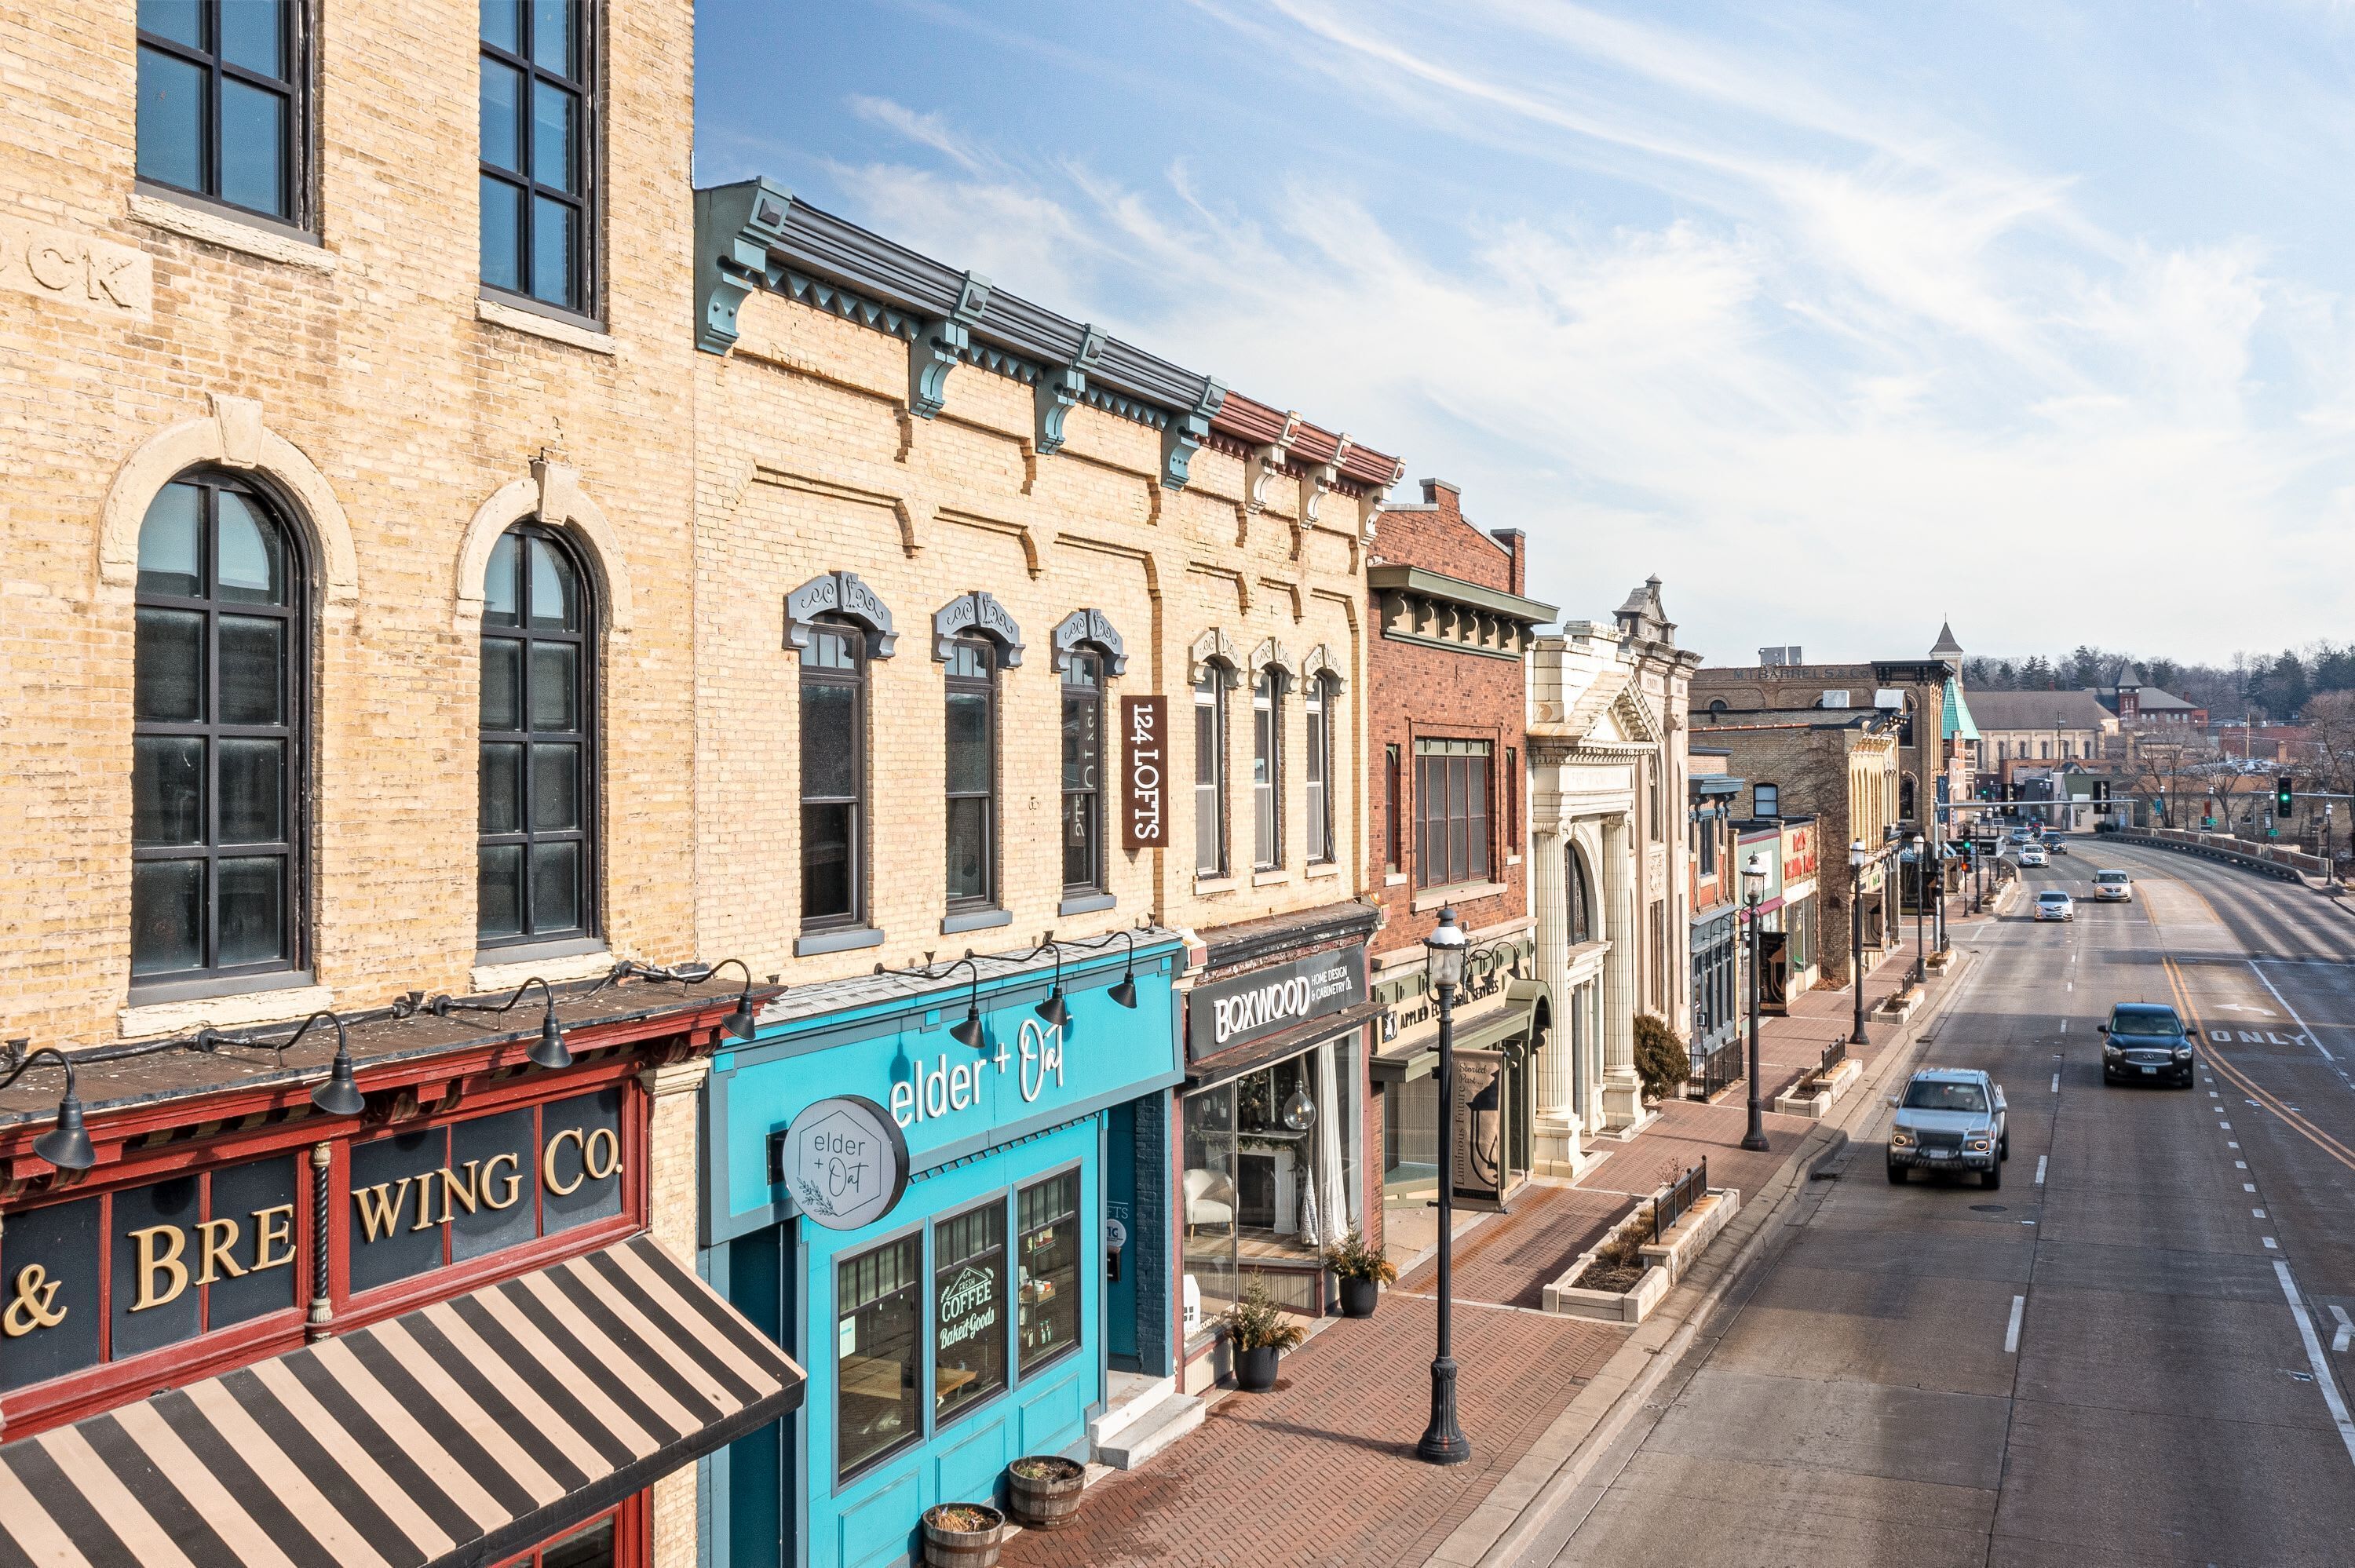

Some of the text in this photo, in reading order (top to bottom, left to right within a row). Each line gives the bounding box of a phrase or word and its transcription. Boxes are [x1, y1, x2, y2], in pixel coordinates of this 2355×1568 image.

[0, 240, 133, 309] CK
[1130, 704, 1159, 839] 124 LOFTS
[1311, 965, 1347, 986] HOME DESIGN
[1311, 990, 1316, 1001] &
[1316, 980, 1345, 1000] CABINETRY
[1213, 975, 1310, 1044] BOXWOOD
[1400, 1005, 1429, 1030] APPLIED
[2210, 1030, 2308, 1046] ONLY
[1459, 1062, 1487, 1074] Storied
[890, 1054, 987, 1128] elder
[814, 1132, 866, 1156] elder
[1455, 1085, 1466, 1186] Luminous Future
[829, 1157, 869, 1197] Oat
[1107, 1205, 1128, 1219] FTS
[2, 1264, 68, 1337] &
[942, 1280, 992, 1322] COFFEE
[959, 1278, 975, 1292] FRESH
[940, 1307, 995, 1350] Baked Goods
